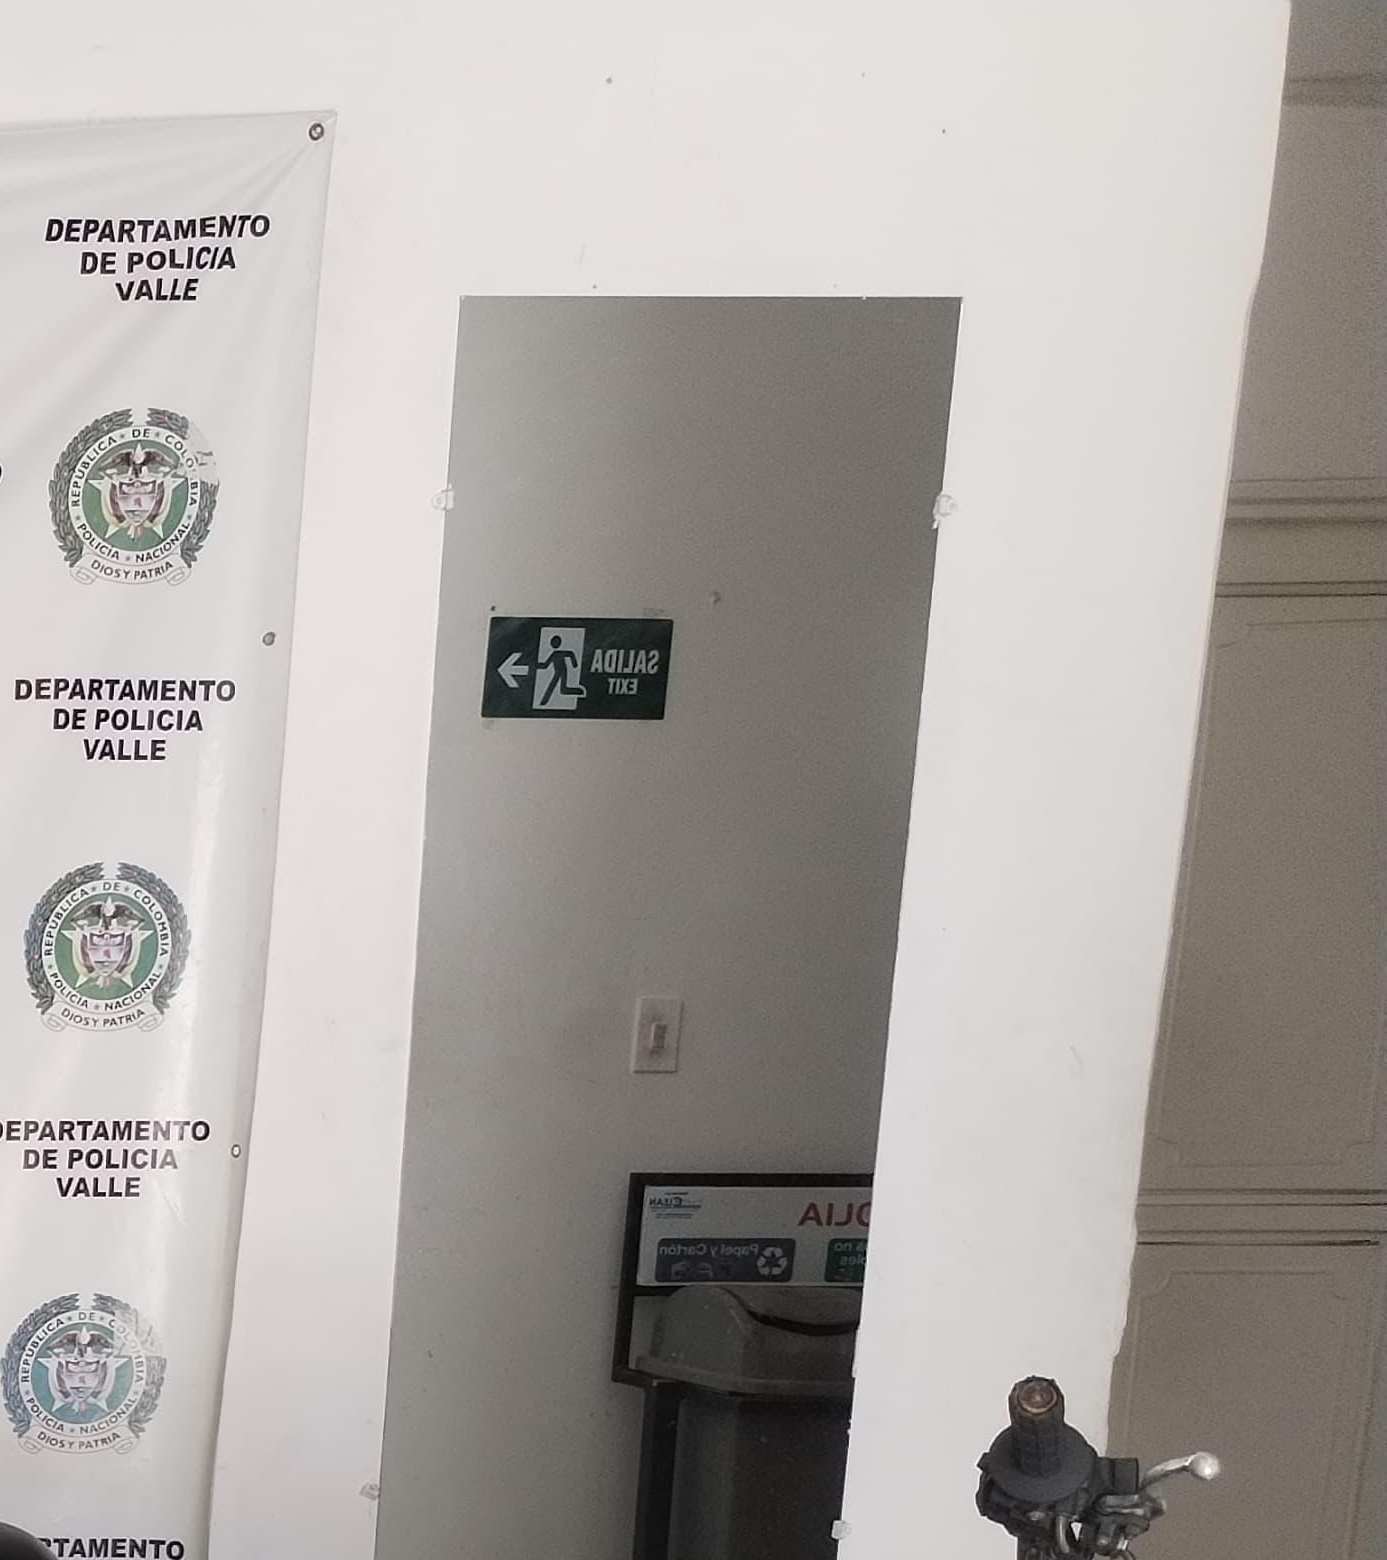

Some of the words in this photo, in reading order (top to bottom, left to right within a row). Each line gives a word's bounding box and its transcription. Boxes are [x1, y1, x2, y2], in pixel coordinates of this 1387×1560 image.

[45, 214, 271, 243] DEPARTAMENTO
[80, 251, 117, 275] DE
[127, 246, 236, 274] POLICIA
[114, 277, 200, 302] VALLE
[14, 678, 236, 702] DEPARTAMENTO
[53, 708, 87, 730] DE
[94, 708, 204, 732] POLICIA
[83, 738, 167, 761] VALLE
[44, 888, 90, 957] REPUBLICA
[102, 881, 122, 891] DE
[133, 889, 169, 956] COLOMBIA
[49, 972, 89, 1009] POLICIA
[104, 972, 163, 1012] NACIONAL
[102, 1008, 146, 1027] PATRIA
[23, 1148, 59, 1170] DE
[67, 1147, 179, 1170] POLICIA
[56, 1176, 141, 1198] VALLE
